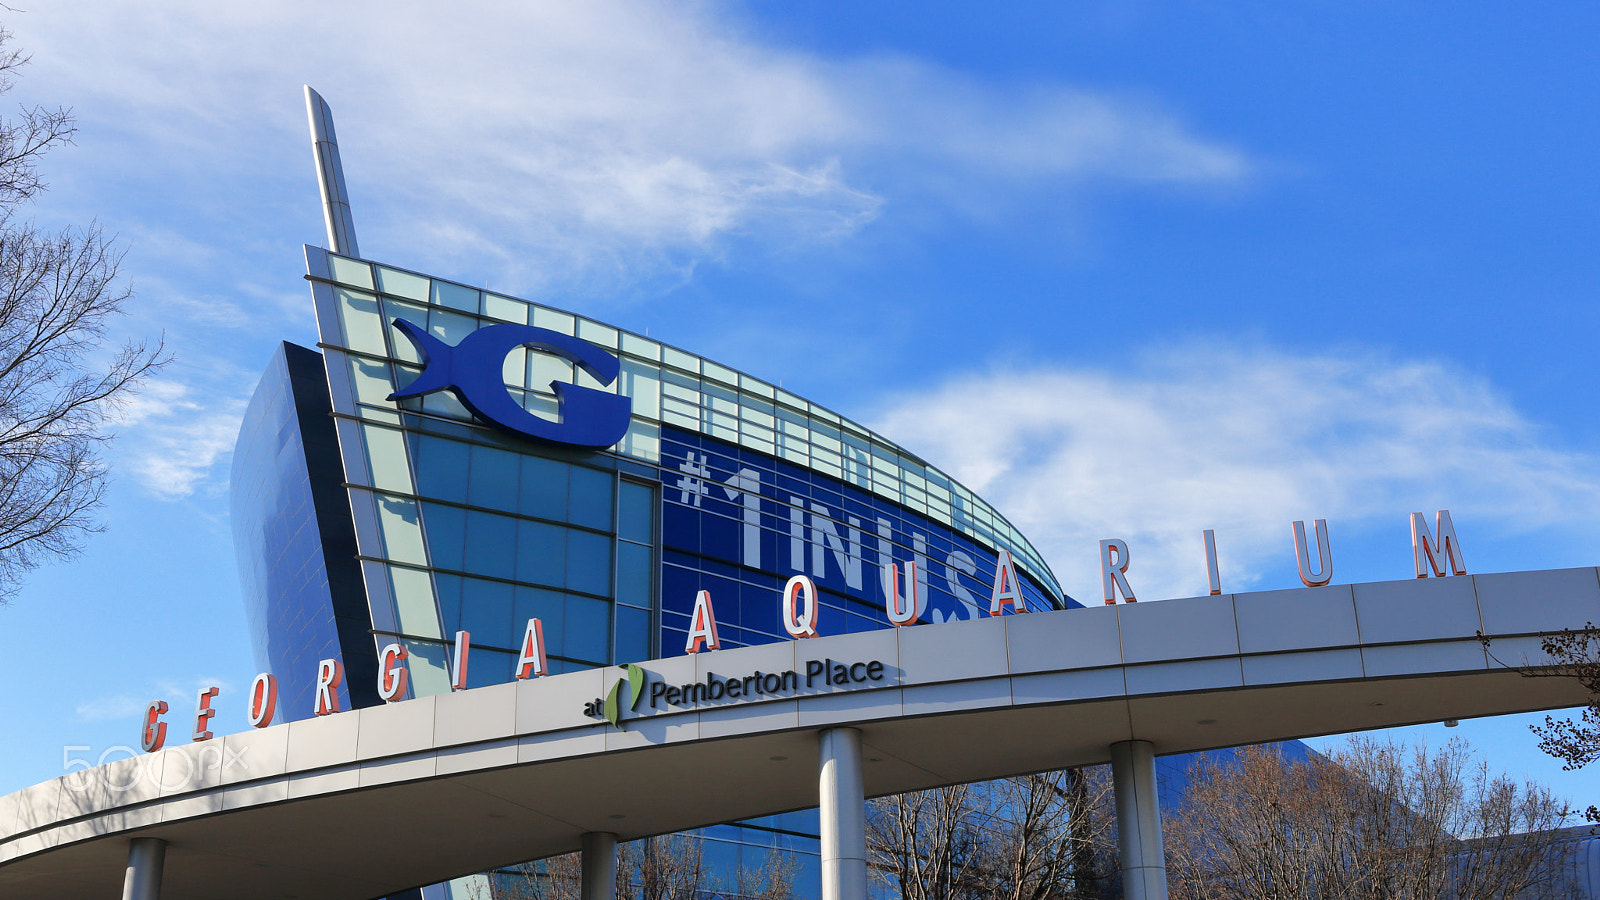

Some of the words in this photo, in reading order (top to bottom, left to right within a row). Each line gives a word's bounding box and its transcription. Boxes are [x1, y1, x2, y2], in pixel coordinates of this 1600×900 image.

[677, 451, 761, 569] #1
[790, 495, 863, 591] IN
[141, 617, 548, 753] GEORGIA
[685, 509, 1468, 654] AQUARIUM
[583, 697, 605, 718] at
[650, 671, 797, 708] Pemberton
[806, 658, 884, 688] Place
